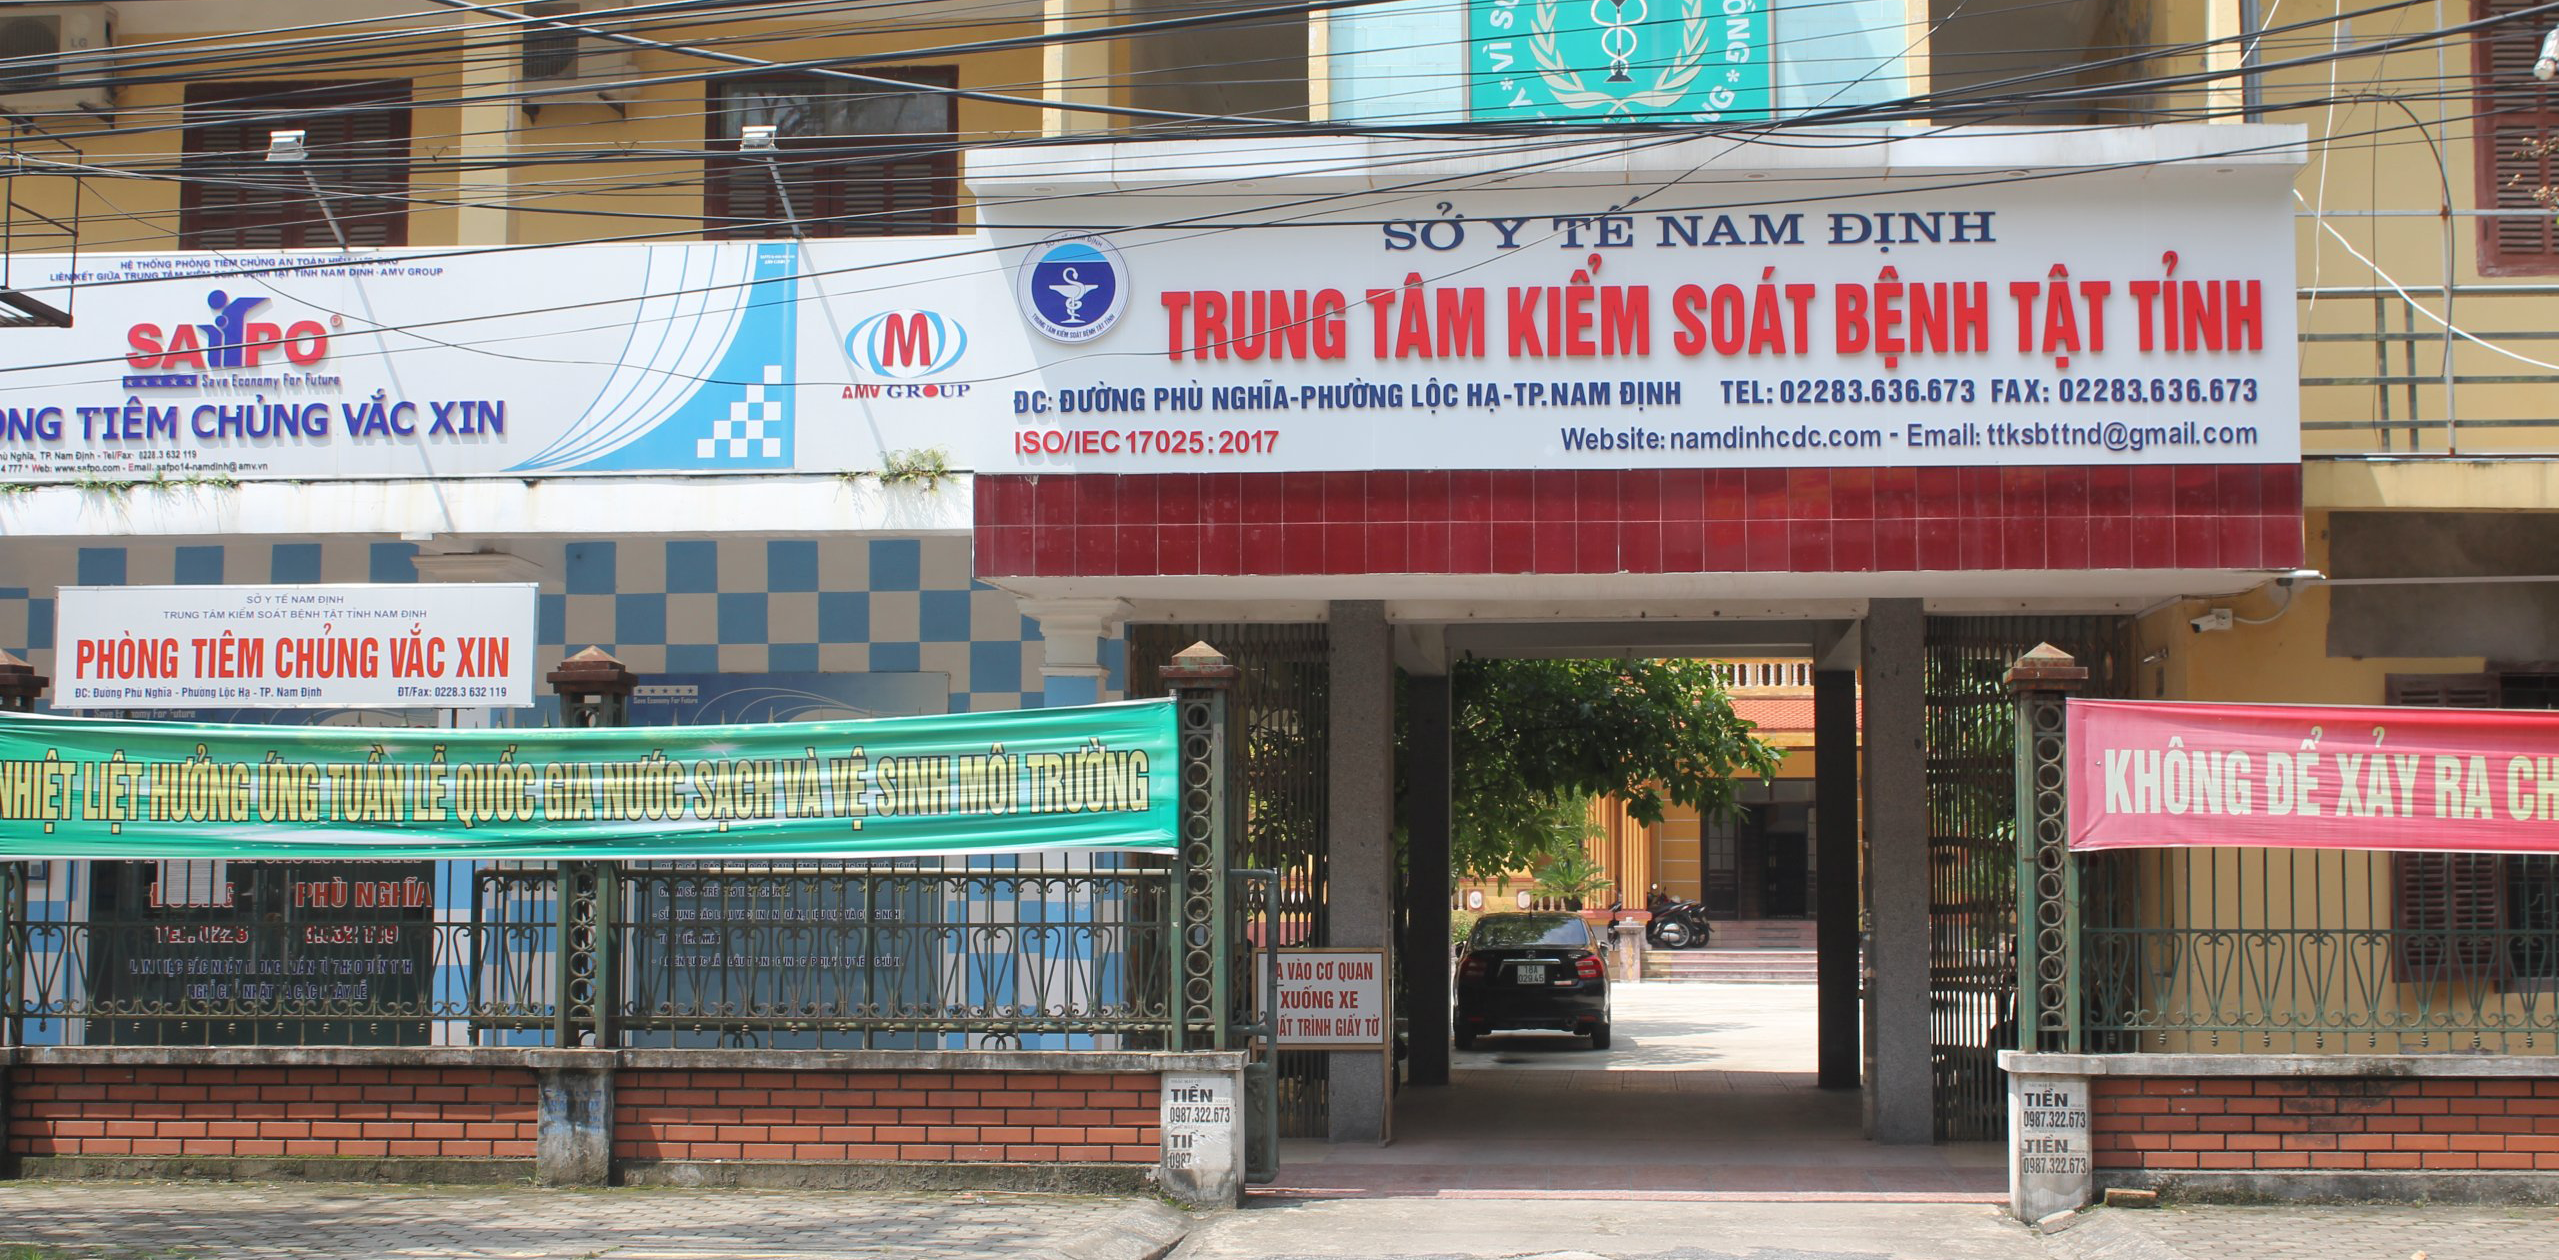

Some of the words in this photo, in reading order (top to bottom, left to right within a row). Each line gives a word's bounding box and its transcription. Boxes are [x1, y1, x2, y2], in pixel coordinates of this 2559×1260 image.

[1382, 202, 1464, 251] SỞ
[1486, 216, 1531, 249] Y
[1553, 197, 1640, 249] TẾ
[1657, 212, 1804, 248] NAM
[1828, 211, 1996, 253] ĐỊNH
[121, 261, 133, 270] HỆ
[175, 257, 210, 268] PHÒNG
[278, 258, 293, 267] AN
[124, 271, 159, 280] TRUNG
[321, 268, 345, 277] NAM
[349, 268, 373, 279] ĐỊNH
[381, 268, 405, 277] AMV
[407, 268, 443, 276] GROUP
[1161, 289, 1347, 361] TRUNG
[1365, 271, 1485, 359] TÂM
[1507, 253, 1650, 358] KIỂM
[1673, 265, 1815, 356] SOÁT
[1835, 265, 1989, 369] BỆNH
[2009, 263, 2111, 369] TẬT
[2130, 250, 2263, 353] TỈNH
[882, 313, 931, 367] M
[202, 374, 228, 387] Save
[232, 373, 279, 389] Economy
[283, 373, 300, 386] For
[305, 372, 339, 386] Future
[842, 384, 880, 399] AMV
[887, 384, 970, 399] GROUP
[1014, 390, 1052, 414] ĐC:
[1059, 380, 1145, 413] ĐƯỜNG
[1154, 379, 1203, 411] PHÙ
[1412, 376, 1457, 415] LỘC
[1619, 381, 1681, 412] ĐỊNH
[1720, 380, 1774, 404] TEL:
[1779, 378, 1976, 404] 02283.636.673
[1990, 378, 2050, 404] FAX:
[2058, 377, 2258, 403] 02283.636.673
[76, 395, 178, 440] TIÊM
[191, 393, 329, 439] CHỦNG
[341, 388, 416, 437] VẮC
[428, 400, 506, 436] XIN
[1014, 430, 1121, 454] ISO/IEC
[1560, 427, 1665, 452] Website:
[1672, 425, 1881, 450] namdinhcdc.com
[1906, 422, 1981, 447] Email:
[1986, 420, 2258, 452] ttksbttnd@gmail.com
[54, 452, 73, 460] Nam
[75, 451, 95, 461] Định
[166, 451, 180, 459] 632
[183, 450, 197, 459] 119
[8, 464, 22, 473] 777
[247, 594, 261, 604] SỞ
[265, 596, 272, 604] Y
[275, 594, 288, 604] TẾ
[292, 596, 315, 604] NAM
[318, 595, 344, 605] ĐỊNH
[163, 611, 200, 619] TRUNG
[203, 609, 225, 619] TÂM
[228, 607, 254, 619] KIỂM
[257, 608, 287, 619] SOÁT
[290, 608, 320, 621] BỆNH
[323, 608, 343, 621] TẬT
[347, 608, 371, 619] TỈNH
[374, 611, 398, 619] NAM
[401, 610, 428, 620] ĐỊNH
[76, 630, 179, 679] PHÒNG
[192, 629, 264, 679] TIÊM
[275, 623, 378, 679] CHỦNG
[389, 623, 445, 678] VẮC
[456, 637, 509, 678] XIN
[75, 688, 90, 698] ĐC:
[145, 686, 172, 699] Nghĩa
[219, 686, 235, 700] Lộc
[238, 687, 250, 700] Hạ
[260, 687, 274, 697] TP.
[277, 687, 298, 697] Nam
[301, 687, 322, 699] Định
[398, 686, 432, 697] ĐT/Fax:
[435, 687, 466, 697] 0228.3
[469, 687, 487, 697] 632
[490, 687, 507, 697] 119
[2105, 736, 2252, 815] KHÔNG
[2266, 726, 2324, 817] ĐỂ
[2335, 726, 2420, 819] XẢY
[2434, 755, 2493, 820] RA
[0, 748, 77, 834] NHIỆT
[83, 749, 144, 834] LIỆT
[149, 743, 250, 822] HƯỞNG
[258, 751, 320, 823] ỨNG
[327, 744, 406, 823] TUẦN
[412, 744, 447, 822] LỄ
[455, 744, 536, 829] QUỐC
[544, 761, 595, 822] GIA
[600, 748, 688, 821] NƯỚC
[692, 757, 776, 832] SẠCH
[782, 747, 823, 818] VÀ
[830, 746, 870, 830] VỆ
[876, 755, 950, 817] SINH
[959, 742, 1018, 816] MÔI
[1026, 737, 1150, 813] TRƯỜNG
[1288, 958, 1312, 980] VÀO
[1316, 961, 1334, 980] CƠ
[1338, 962, 1373, 982] QUAN
[1280, 985, 1334, 1009] XUỐNG
[1339, 990, 1358, 1009] XE
[1297, 1013, 1331, 1036] TRÌNH
[1336, 1013, 1361, 1036] GIẤY
[1365, 1013, 1380, 1036] TỜ
[1171, 1083, 1213, 1103] TIỀN
[2024, 1088, 2068, 1107] TIỀN
[1170, 1107, 1231, 1123] 0987.322.673
[2024, 1111, 2086, 1128] 0987.322.673
[2024, 1134, 2068, 1153] TIỀN
[2024, 1157, 2087, 1174] 0987.322.673
